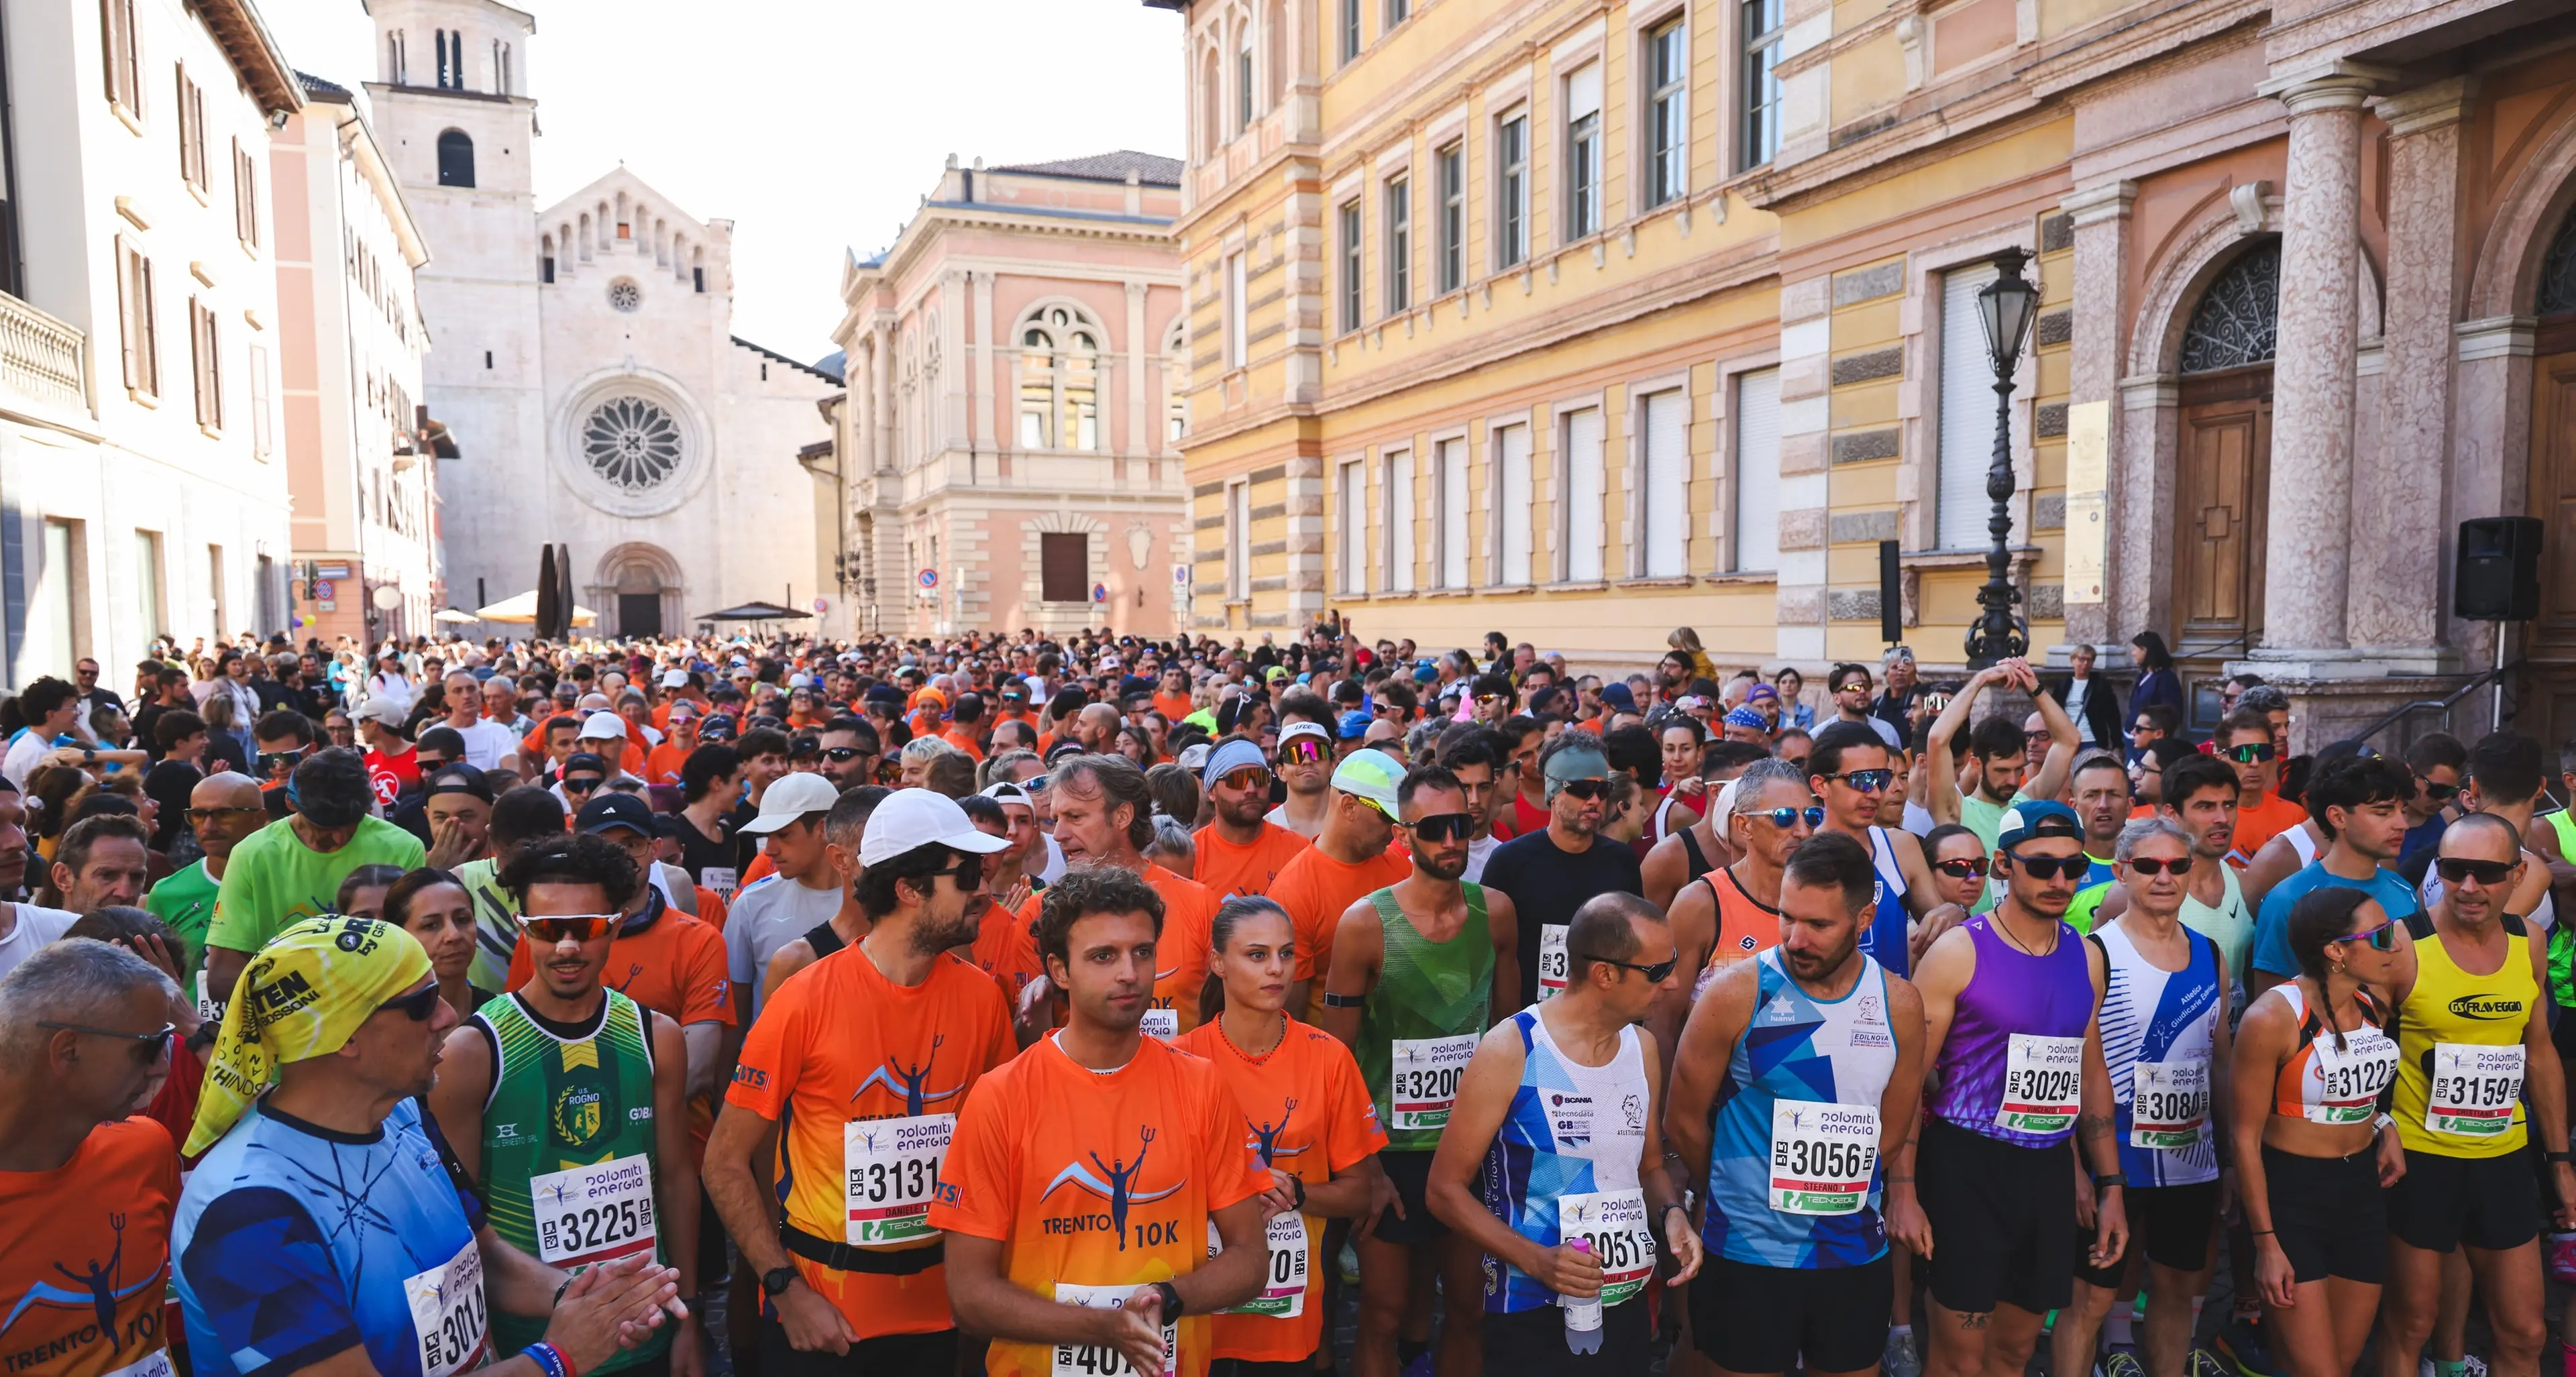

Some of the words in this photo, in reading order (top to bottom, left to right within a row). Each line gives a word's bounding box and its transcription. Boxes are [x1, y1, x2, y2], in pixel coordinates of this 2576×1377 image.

[357, 942, 378, 957] by
[2181, 984, 2202, 1005] Atletica
[262, 990, 321, 1027] BOSSONI
[2171, 998, 2202, 1028] Giudicarie
[2466, 1001, 2522, 1012] FRAVEGGIO
[1141, 1016, 1170, 1026] omiti
[1139, 1027, 1170, 1036] ergia
[1432, 1040, 1474, 1054] Dolomiti
[2354, 1042, 2393, 1056] energia
[2046, 1055, 2078, 1064] energia
[2477, 1062, 2520, 1071] energia
[1409, 1066, 1464, 1099] 3200
[2339, 1059, 2387, 1097] 3122
[2021, 1070, 2070, 1101] 3029
[2451, 1077, 2510, 1107] 3159
[570, 1093, 600, 1105] ROGNO
[2150, 1091, 2200, 1121] 3080
[2027, 1105, 2057, 1113] VINCENZO
[2456, 1109, 2493, 1117] CRISTIANO
[1821, 1111, 1874, 1124] Dolomiti
[896, 1121, 951, 1138] Dolomiti
[1558, 1120, 1574, 1130] GB
[1821, 1123, 1873, 1136] energia
[1792, 1140, 1861, 1178] 3056
[586, 1164, 642, 1186] Dolomiti
[868, 1156, 938, 1202] 3131
[588, 1177, 643, 1198] energia
[1804, 1182, 1838, 1192] STEFANO
[1601, 1197, 1642, 1211] Dolomiti
[1806, 1196, 1856, 1204] TECNOEDIL
[885, 1205, 920, 1217] DANIELE
[1601, 1209, 1642, 1223] energia
[561, 1199, 637, 1252] 3225
[887, 1219, 927, 1230] TECNO
[1269, 1217, 1300, 1230] lomiti
[1042, 1214, 1111, 1234] TRENTO
[1135, 1220, 1179, 1248] 10K
[1269, 1230, 1301, 1241] ergia
[1601, 1275, 1622, 1283] COLA
[1242, 1300, 1288, 1309] CNOEDIL
[443, 1282, 486, 1366] 3014
[5, 1323, 98, 1373] TRENTO
